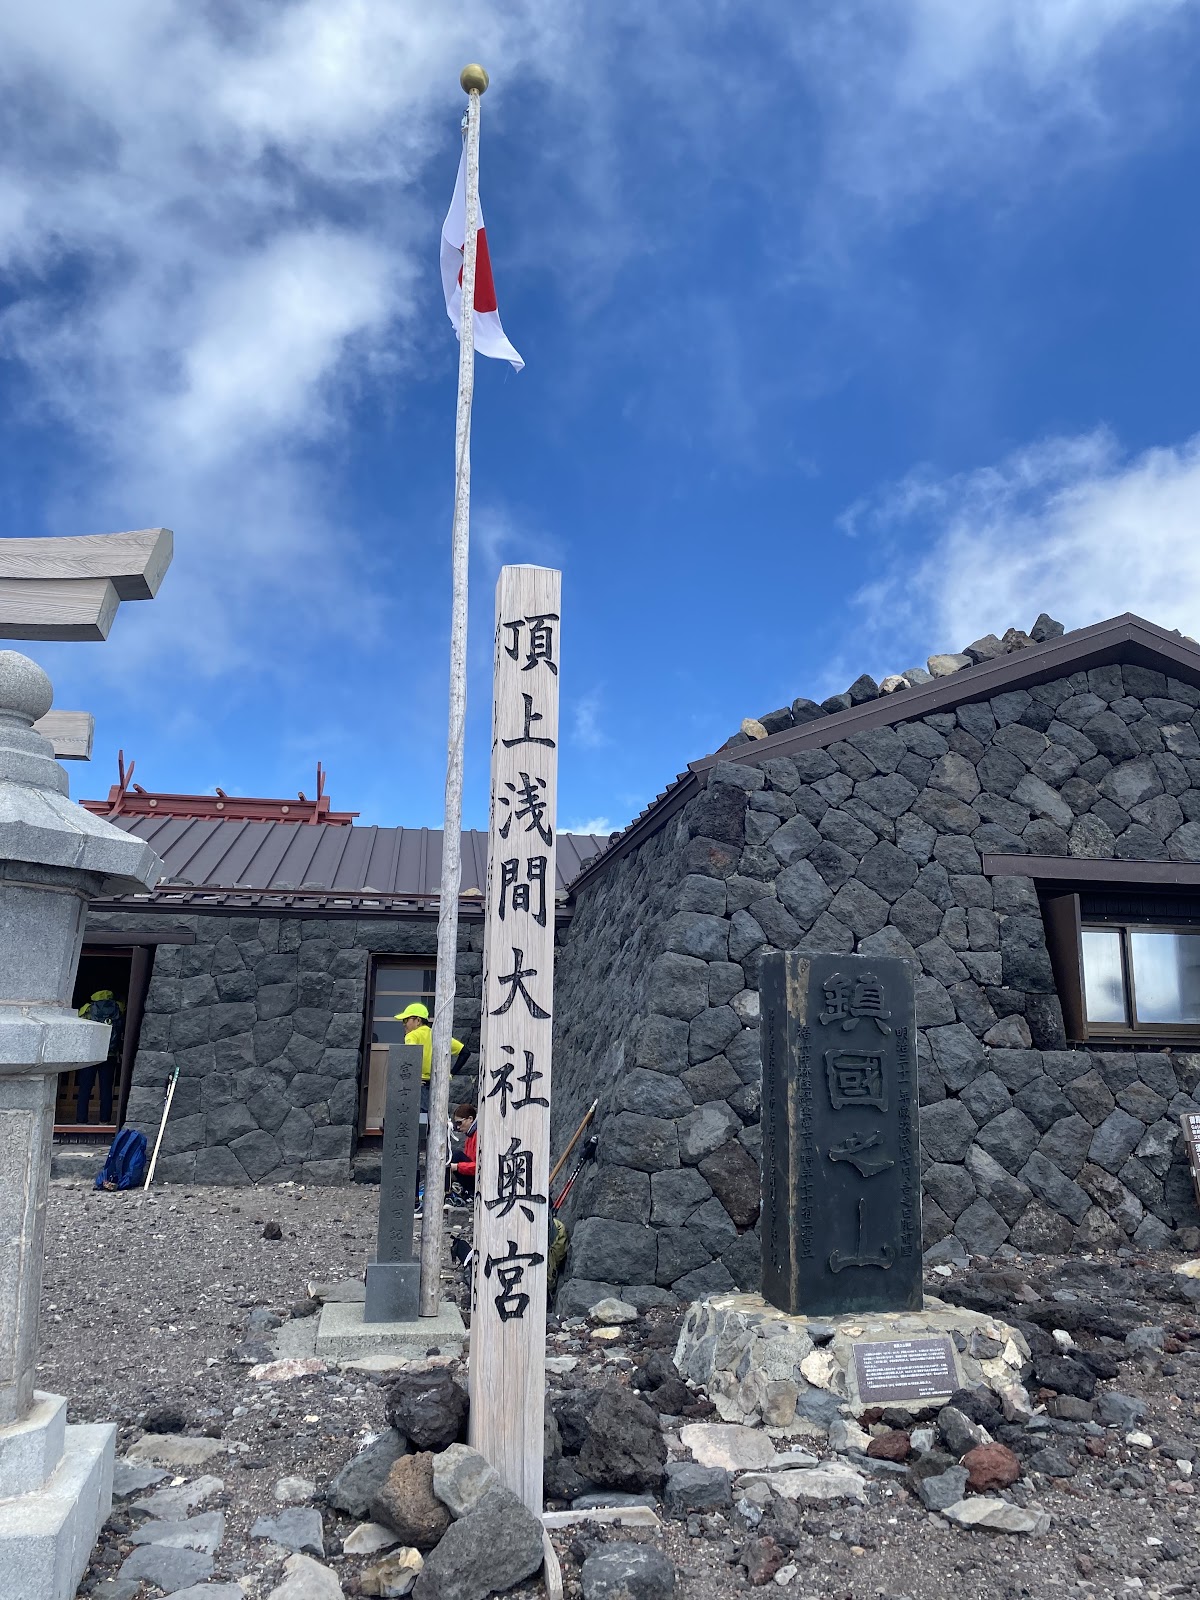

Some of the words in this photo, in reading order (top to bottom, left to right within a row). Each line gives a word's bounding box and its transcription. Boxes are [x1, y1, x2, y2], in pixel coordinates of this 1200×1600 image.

[484, 613, 560, 1323] 頂上浅間大社奥宮
